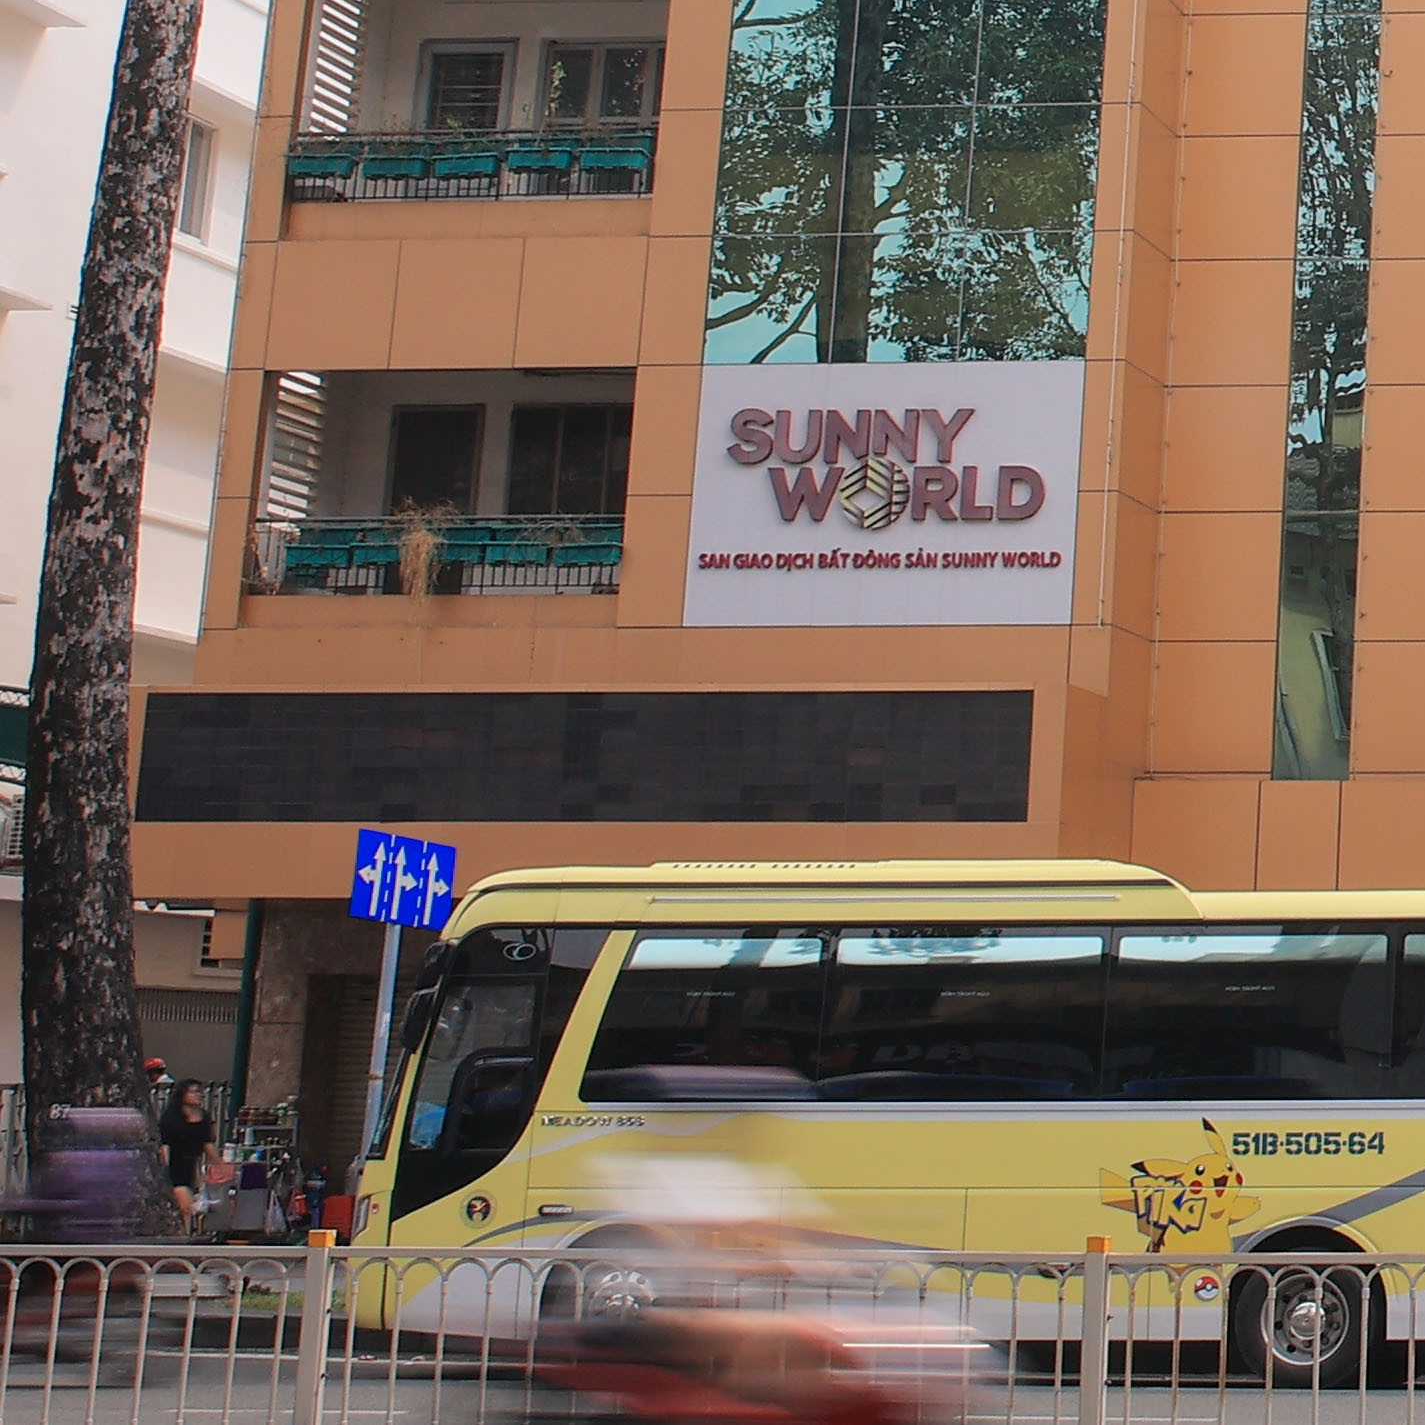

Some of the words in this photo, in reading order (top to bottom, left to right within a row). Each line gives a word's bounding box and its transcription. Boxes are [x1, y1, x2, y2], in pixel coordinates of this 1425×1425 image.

[727, 408, 976, 464] SUNNY
[732, 552, 773, 570] GIAO
[775, 552, 814, 572] DỊCH
[817, 547, 850, 570] BẤT
[941, 551, 999, 569] SUNNY
[1001, 551, 1063, 569] WORLD
